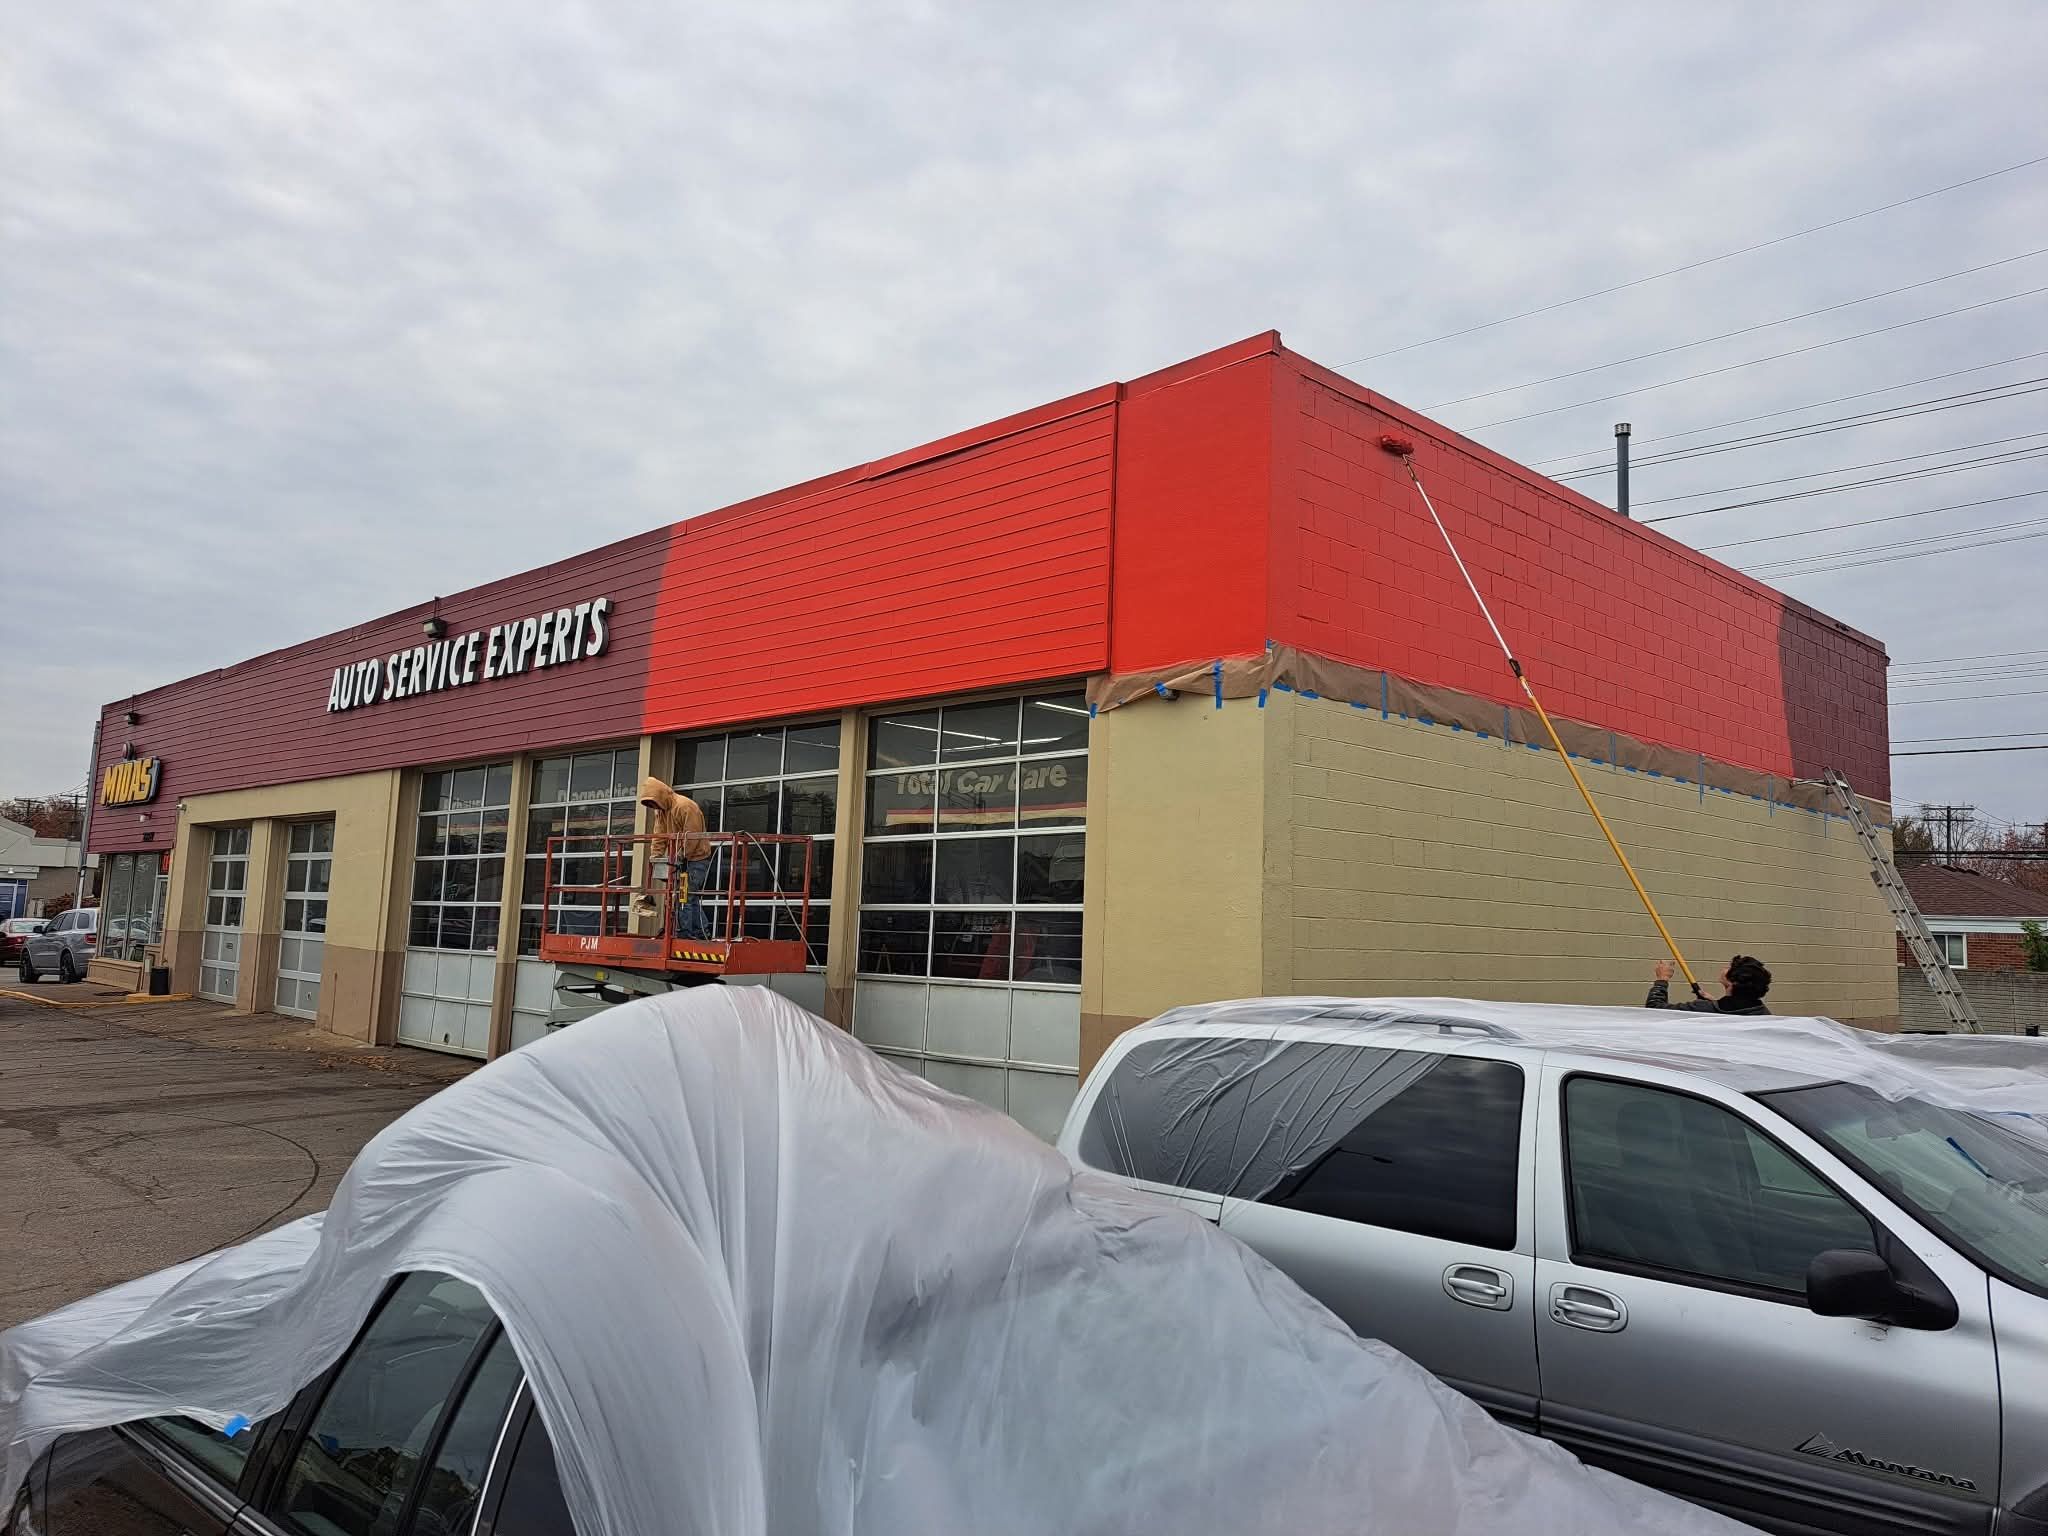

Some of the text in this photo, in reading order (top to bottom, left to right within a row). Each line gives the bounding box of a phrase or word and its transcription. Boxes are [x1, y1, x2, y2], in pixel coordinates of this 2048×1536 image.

[327, 597, 612, 713] AUTO SERVICE EXPERTS
[100, 757, 153, 806] MIDAS
[957, 770, 1003, 793] Car
[1007, 764, 1068, 791] Care
[580, 937, 599, 950] PJM
[1832, 1447, 1978, 1493] Montana
